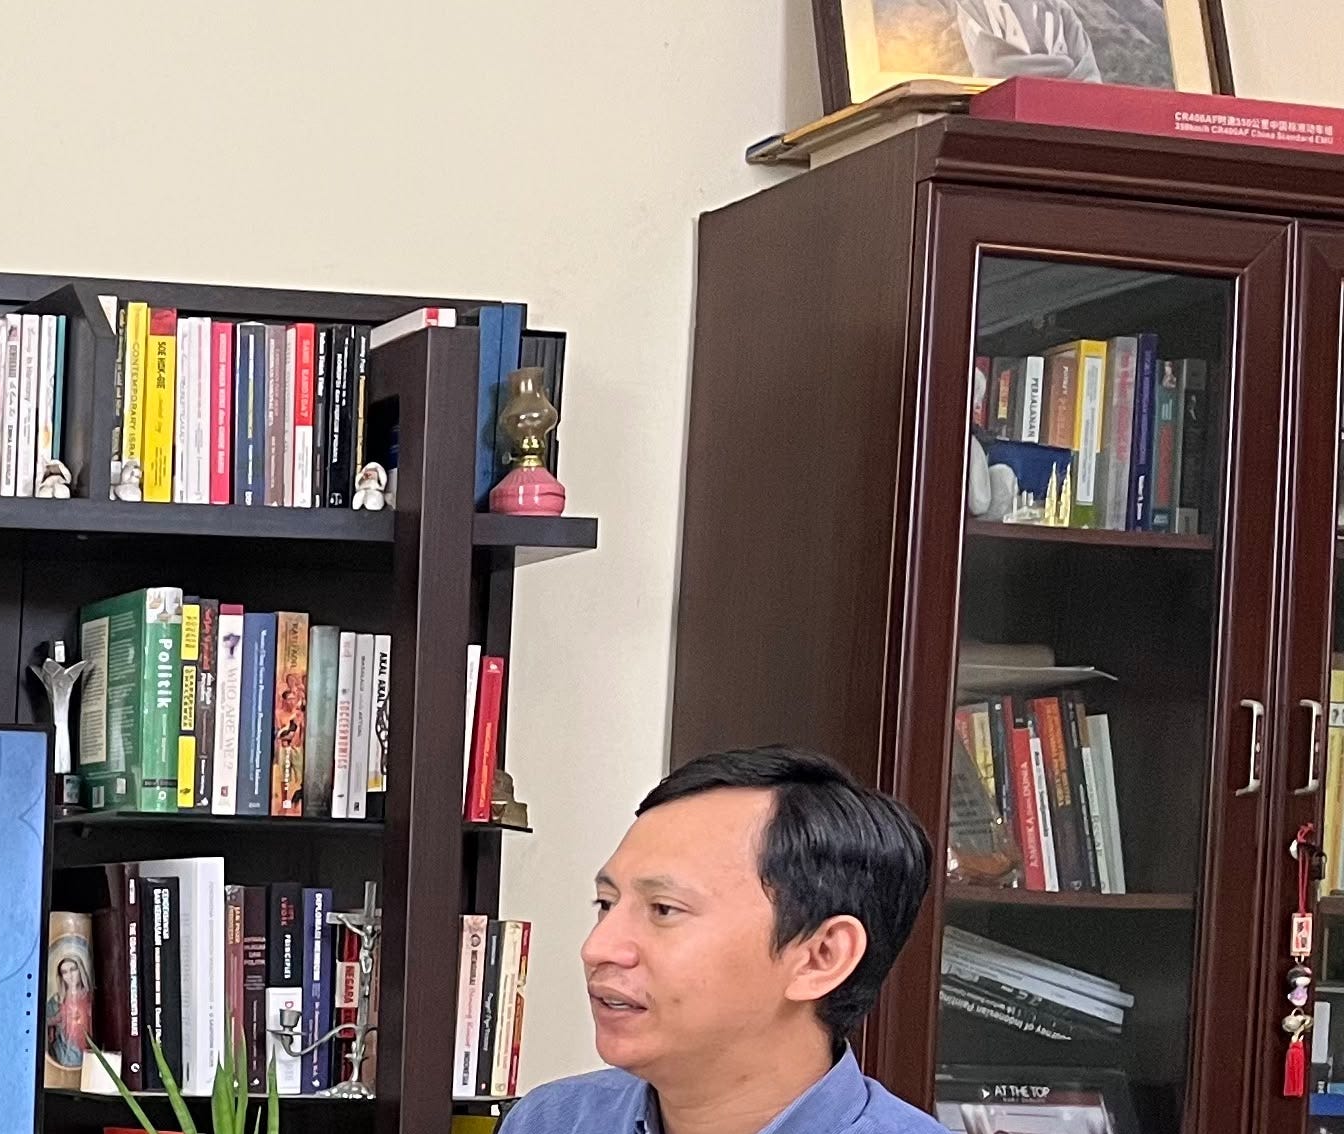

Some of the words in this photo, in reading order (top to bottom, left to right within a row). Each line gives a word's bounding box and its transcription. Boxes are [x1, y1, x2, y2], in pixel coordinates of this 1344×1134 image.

[157, 341, 166, 356] SOE
[128, 343, 140, 430] CONTEMPORARY
[1027, 377, 1039, 439] PERJALANAN
[157, 638, 173, 709] Politik
[378, 651, 388, 676] AKAL
[225, 666, 238, 701] WHO
[377, 679, 387, 704] AKAL
[225, 706, 237, 734] ARE
[337, 700, 351, 769] SOCCERNOMICS
[343, 965, 355, 1004] NEGARA
[994, 1085, 1007, 1097] AT
[1009, 1085, 1030, 1098] THE
[1030, 1085, 1050, 1098] TOP
